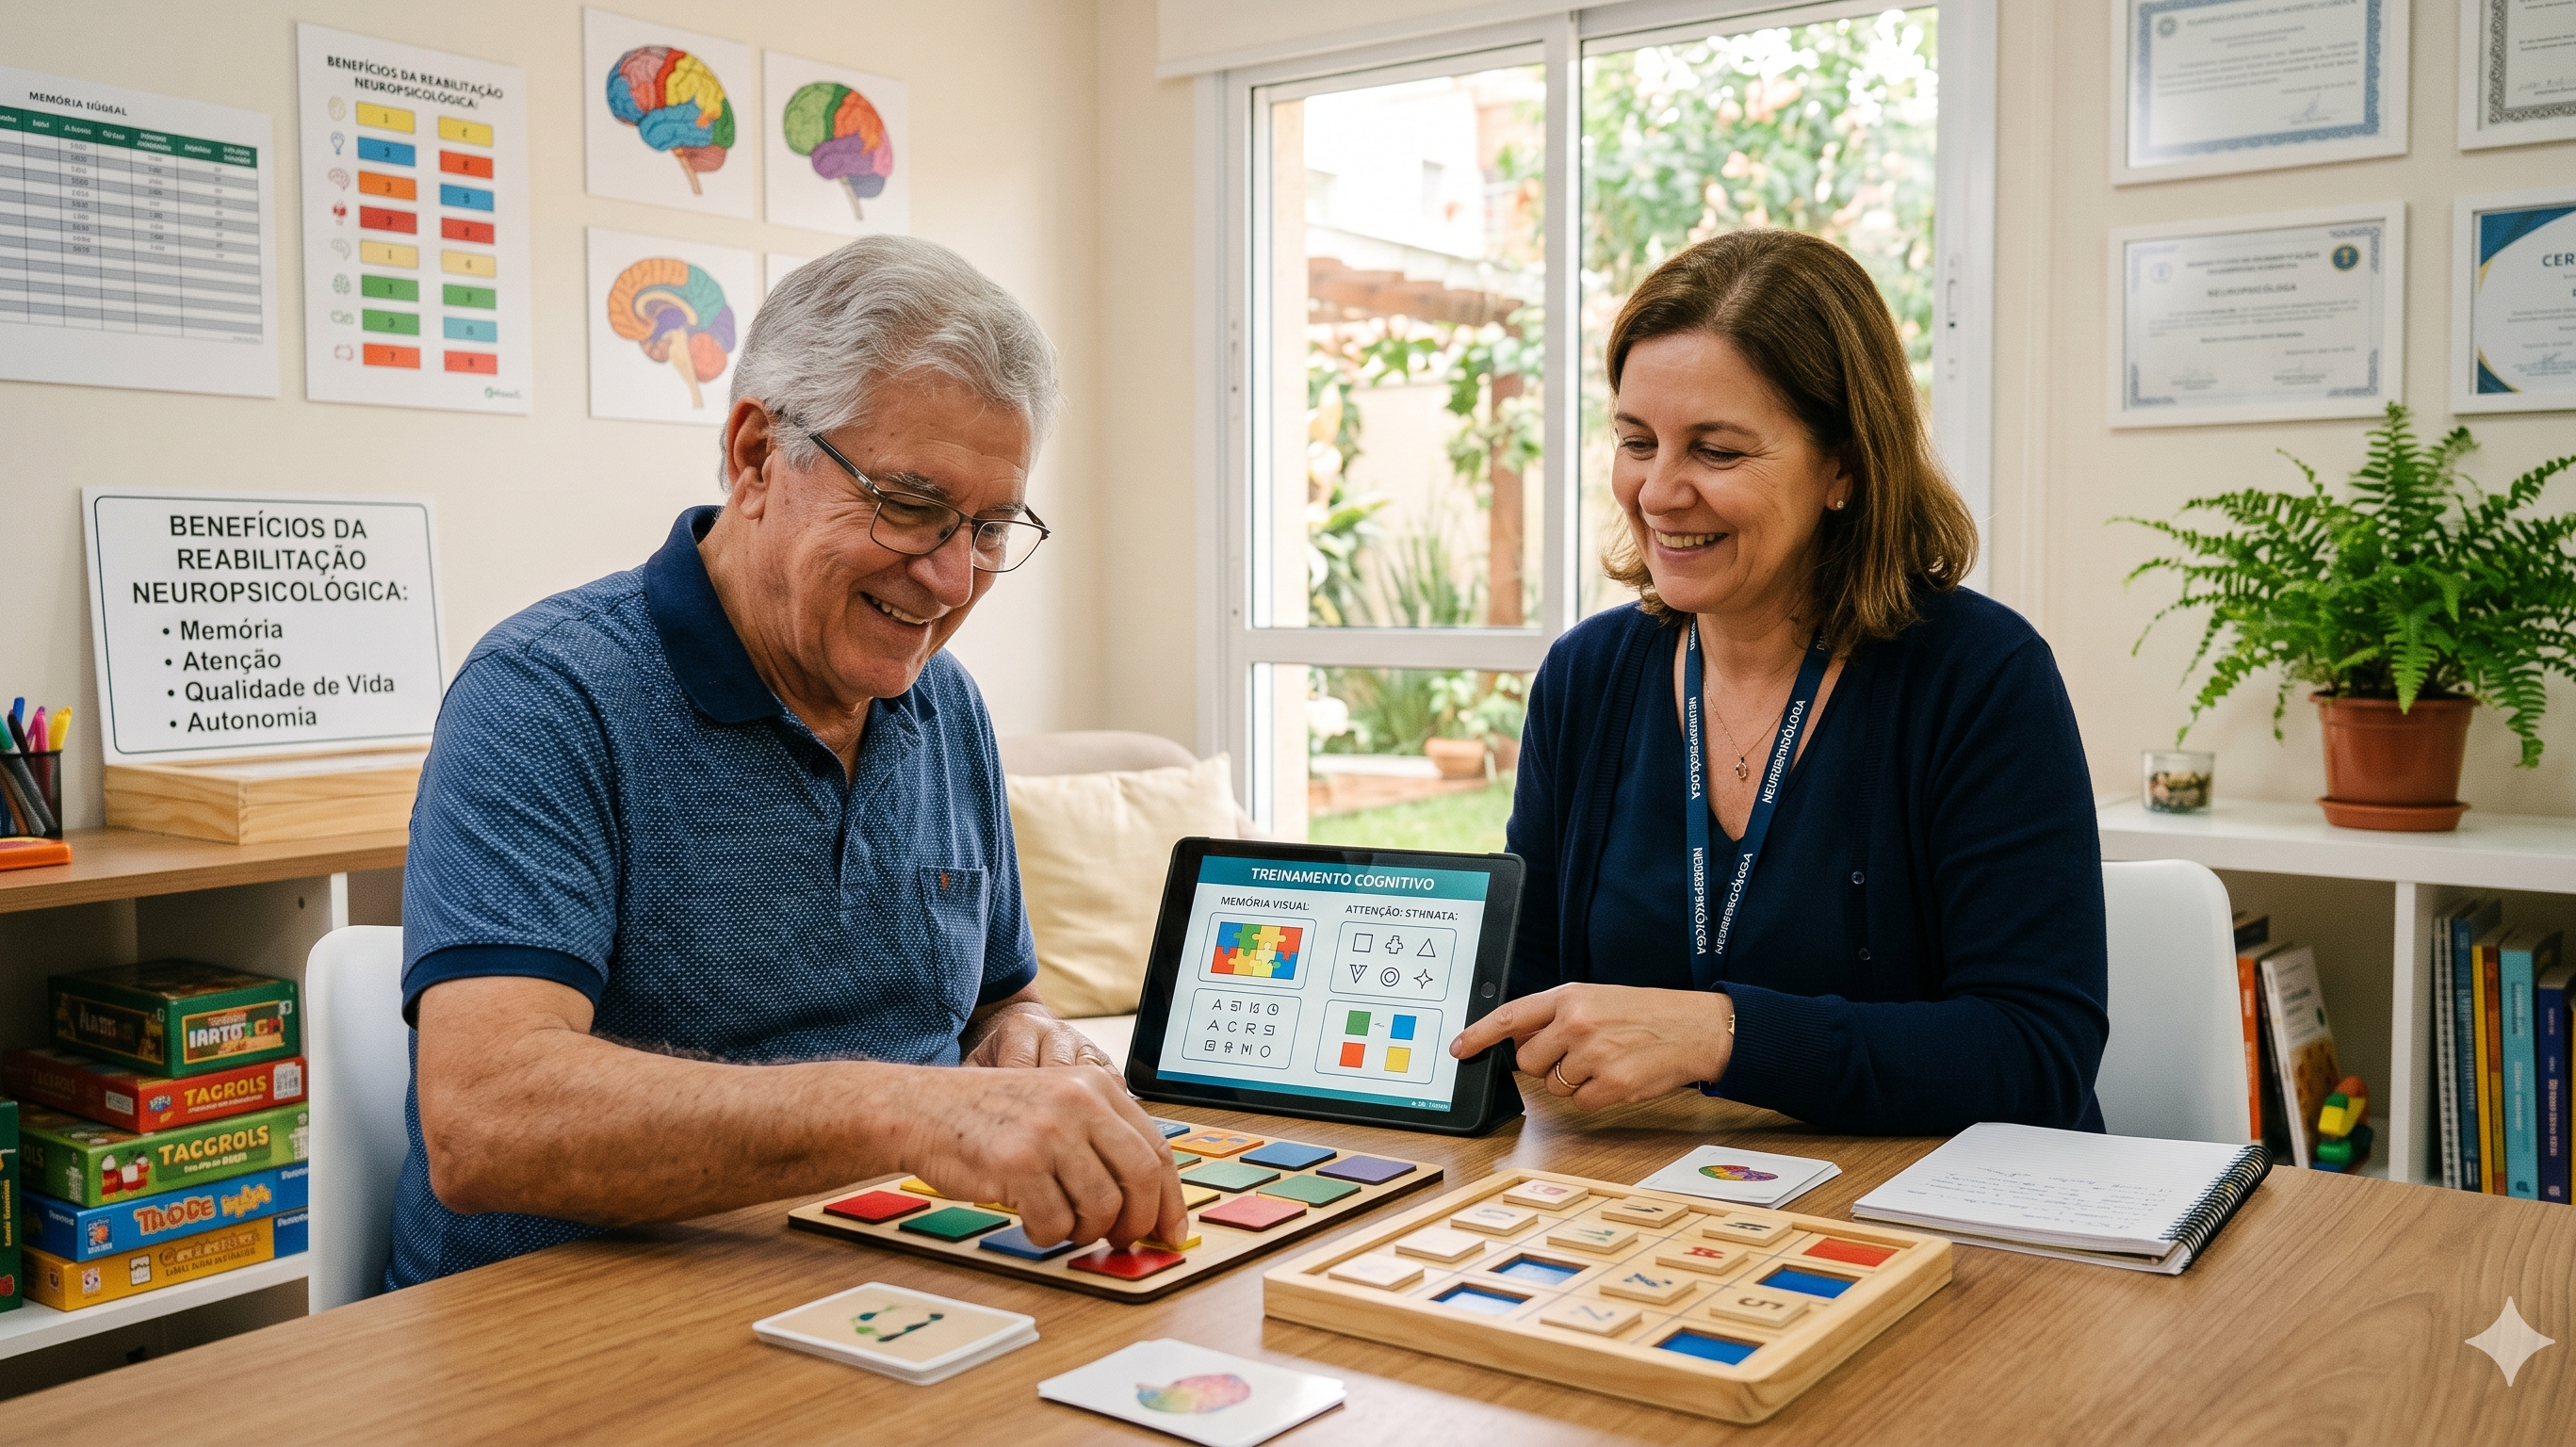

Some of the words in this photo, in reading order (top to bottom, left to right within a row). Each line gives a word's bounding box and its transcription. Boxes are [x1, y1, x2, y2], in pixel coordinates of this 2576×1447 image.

[401, 70, 416, 83] DA
[29, 91, 83, 108] MEMÓRIA
[170, 511, 325, 538] BENEFÍCIOS
[334, 519, 367, 539] DA
[177, 545, 367, 575] REABILITAÇÃO
[133, 576, 409, 604] NEUROPSICOLÓGICA:
[180, 618, 284, 641] Memória
[185, 679, 305, 703] Qualidade
[313, 675, 339, 695] de
[347, 674, 395, 693] Vida
[187, 707, 317, 732] Autonomia
[1251, 868, 1351, 886] TREINAMENTO
[1355, 874, 1435, 890] COGNITIVO
[1220, 896, 1270, 908] MEMÓRIA
[1207, 1019, 1219, 1031] A
[1228, 1021, 1237, 1032] C
[1245, 1022, 1256, 1034] R
[184, 1075, 268, 1107] TAGROLS
[158, 1125, 269, 1166] TACGROLS
